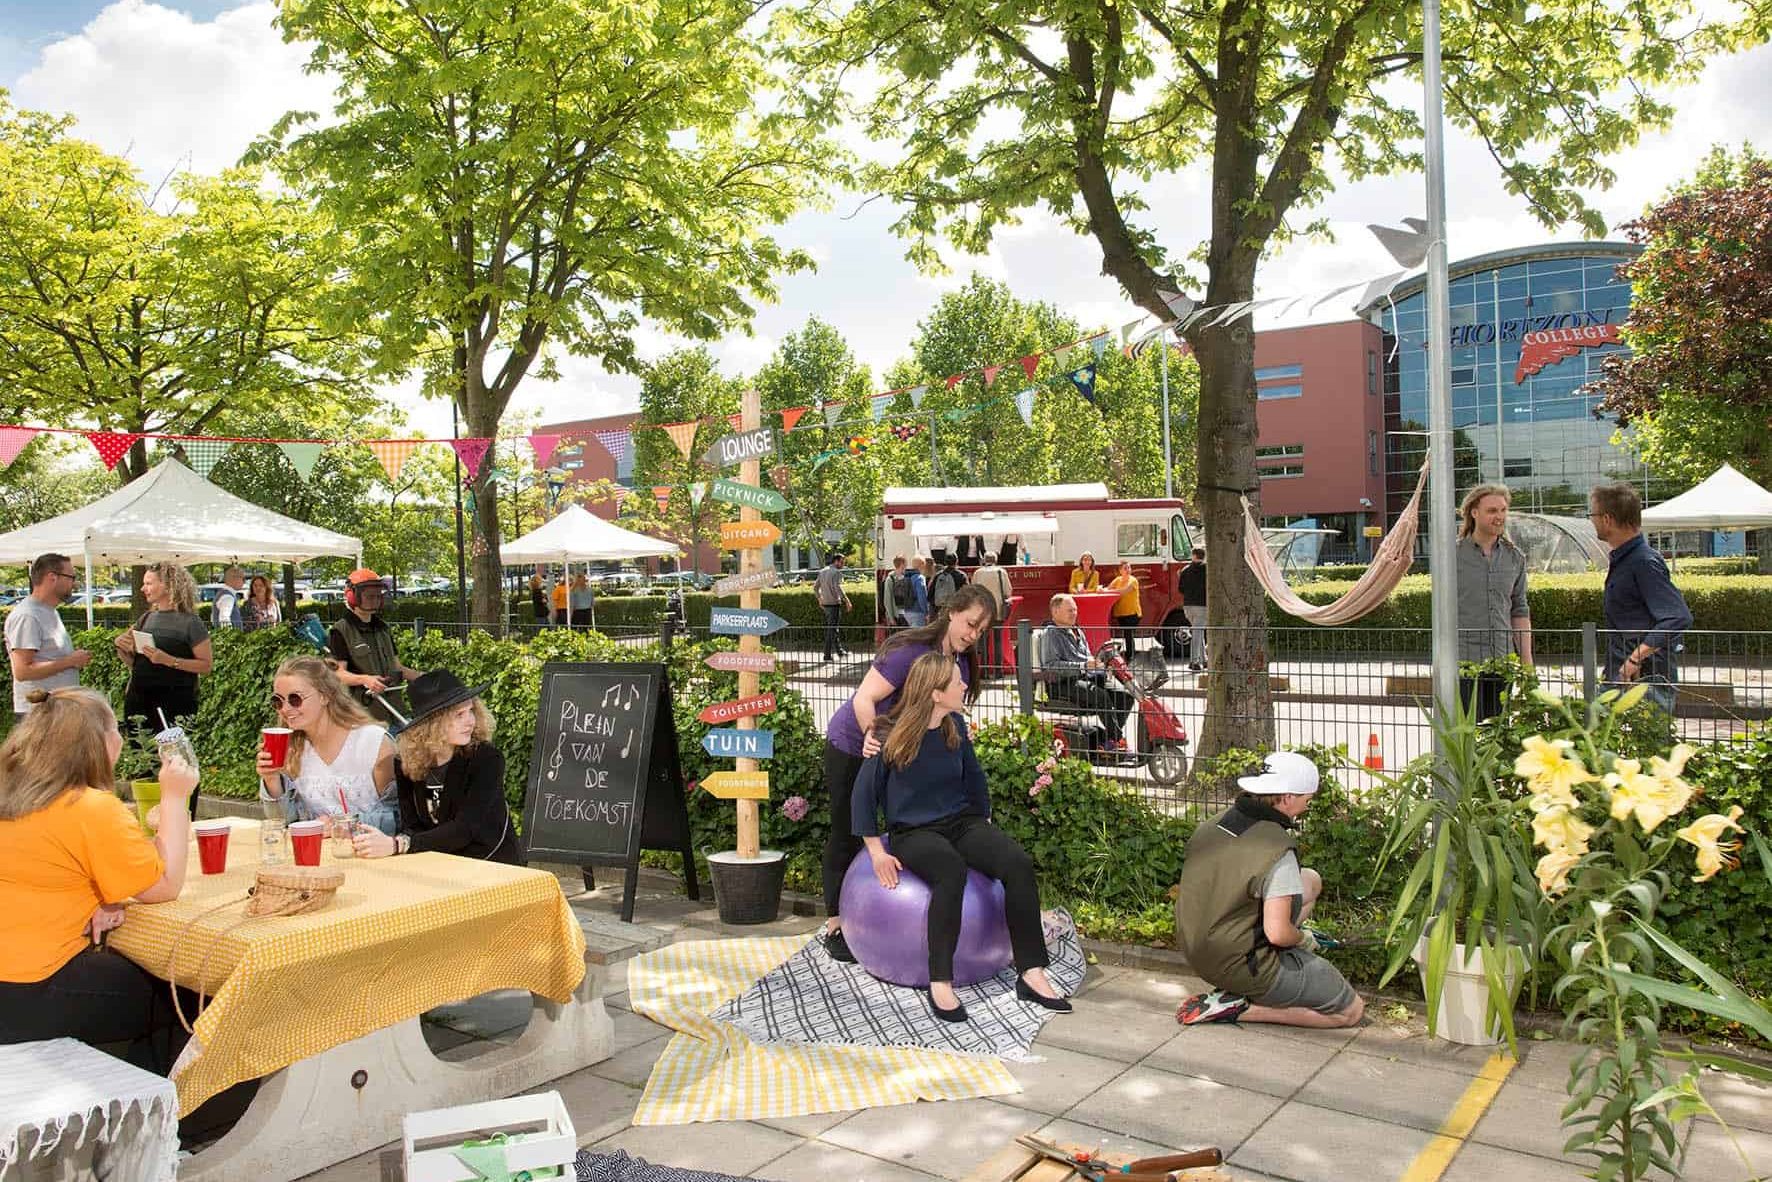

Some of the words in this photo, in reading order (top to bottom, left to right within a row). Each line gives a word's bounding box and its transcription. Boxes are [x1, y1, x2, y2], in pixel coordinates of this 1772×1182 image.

[1450, 309, 1612, 346] HORIZON
[1523, 325, 1609, 346] COLLEGE
[721, 429, 772, 462] LOUNGE
[713, 483, 774, 508] PICKNICK
[722, 529, 769, 540] UITGANG
[712, 613, 769, 629] PARKEERPLAATS
[718, 656, 773, 666] FOODTRUCK
[559, 700, 616, 737] PLEIN
[712, 698, 771, 718] TOILETTEN
[572, 742, 605, 764] VAN
[707, 735, 757, 752] TUIN
[584, 767, 609, 789] DE
[544, 793, 632, 827] TOEKOMST
